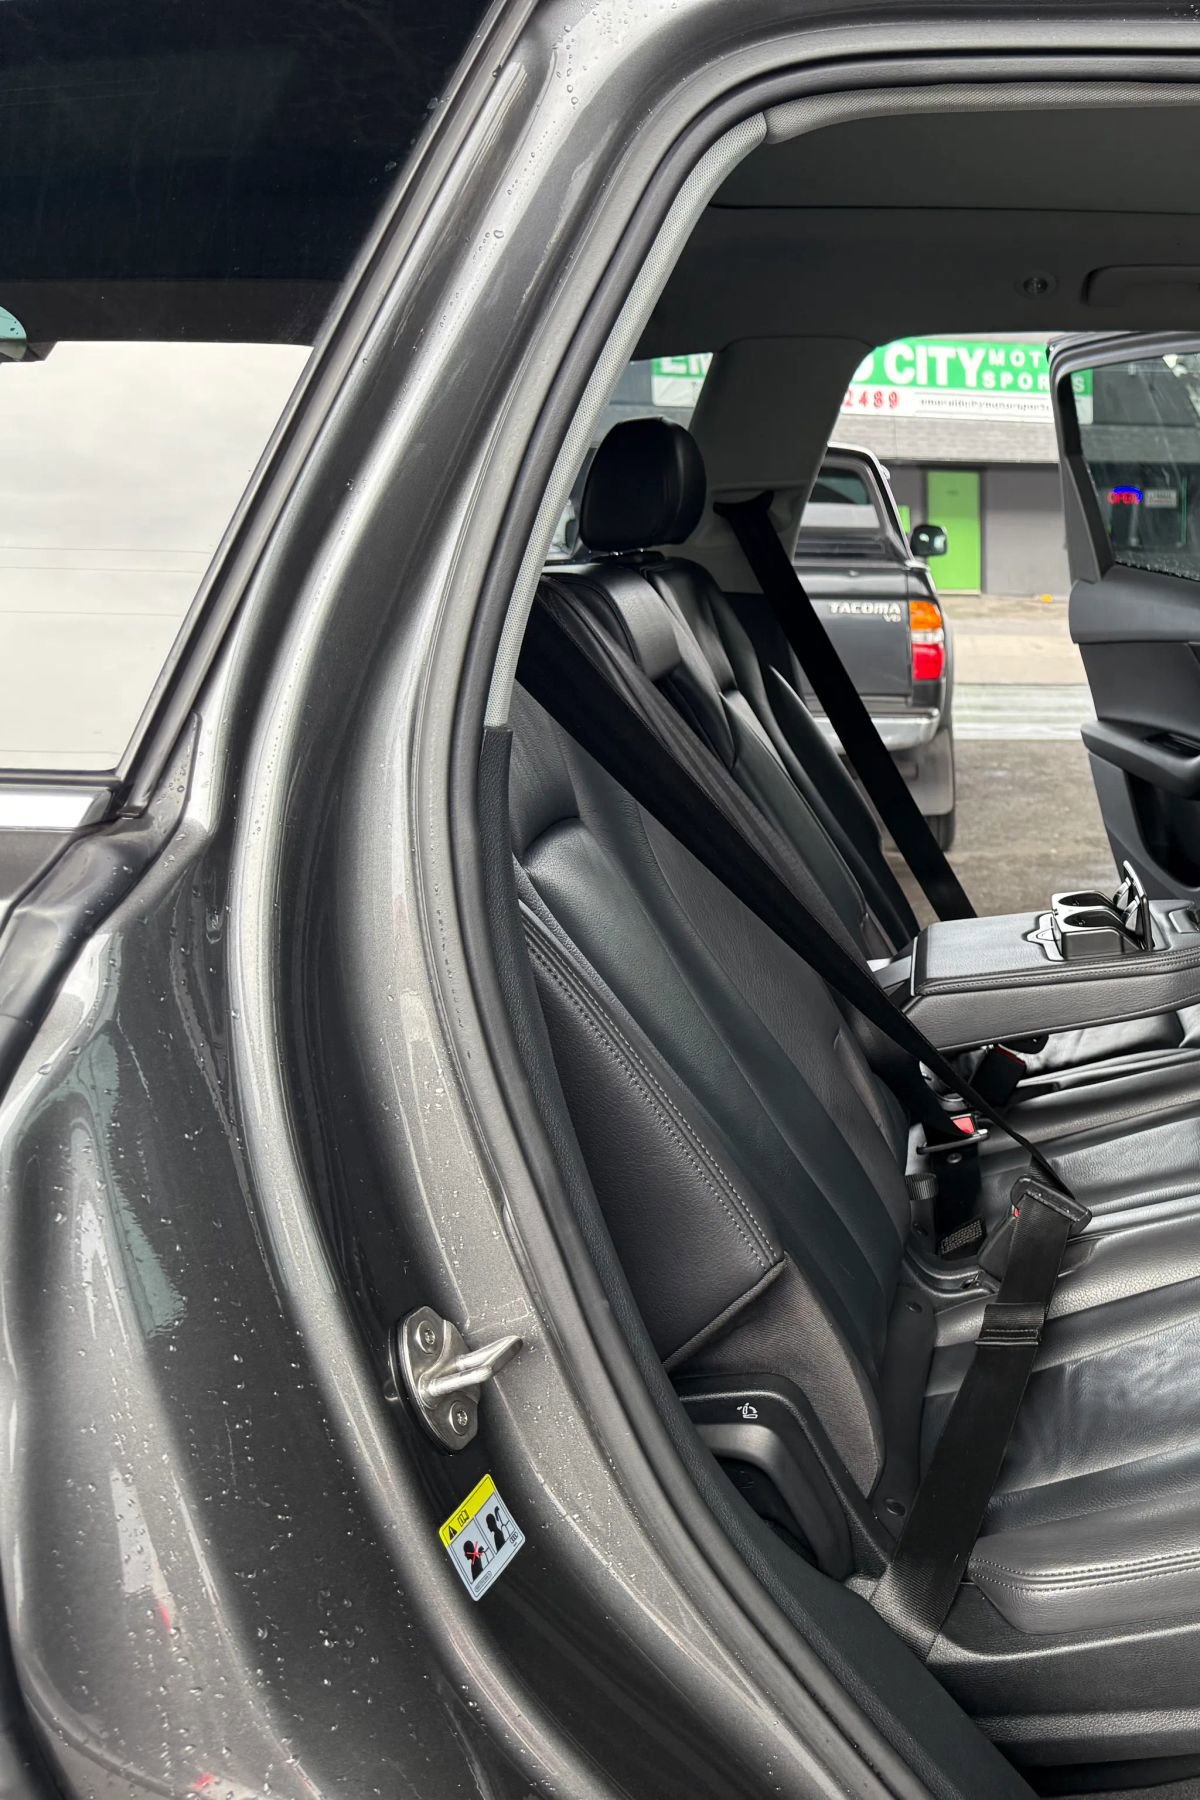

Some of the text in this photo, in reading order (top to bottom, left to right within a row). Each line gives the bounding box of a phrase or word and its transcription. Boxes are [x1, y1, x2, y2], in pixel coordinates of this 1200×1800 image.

[884, 342, 986, 388] CITY
[988, 347, 1043, 368] MOT
[981, 370, 1085, 394] SPORS
[829, 602, 901, 614] TACOMA
